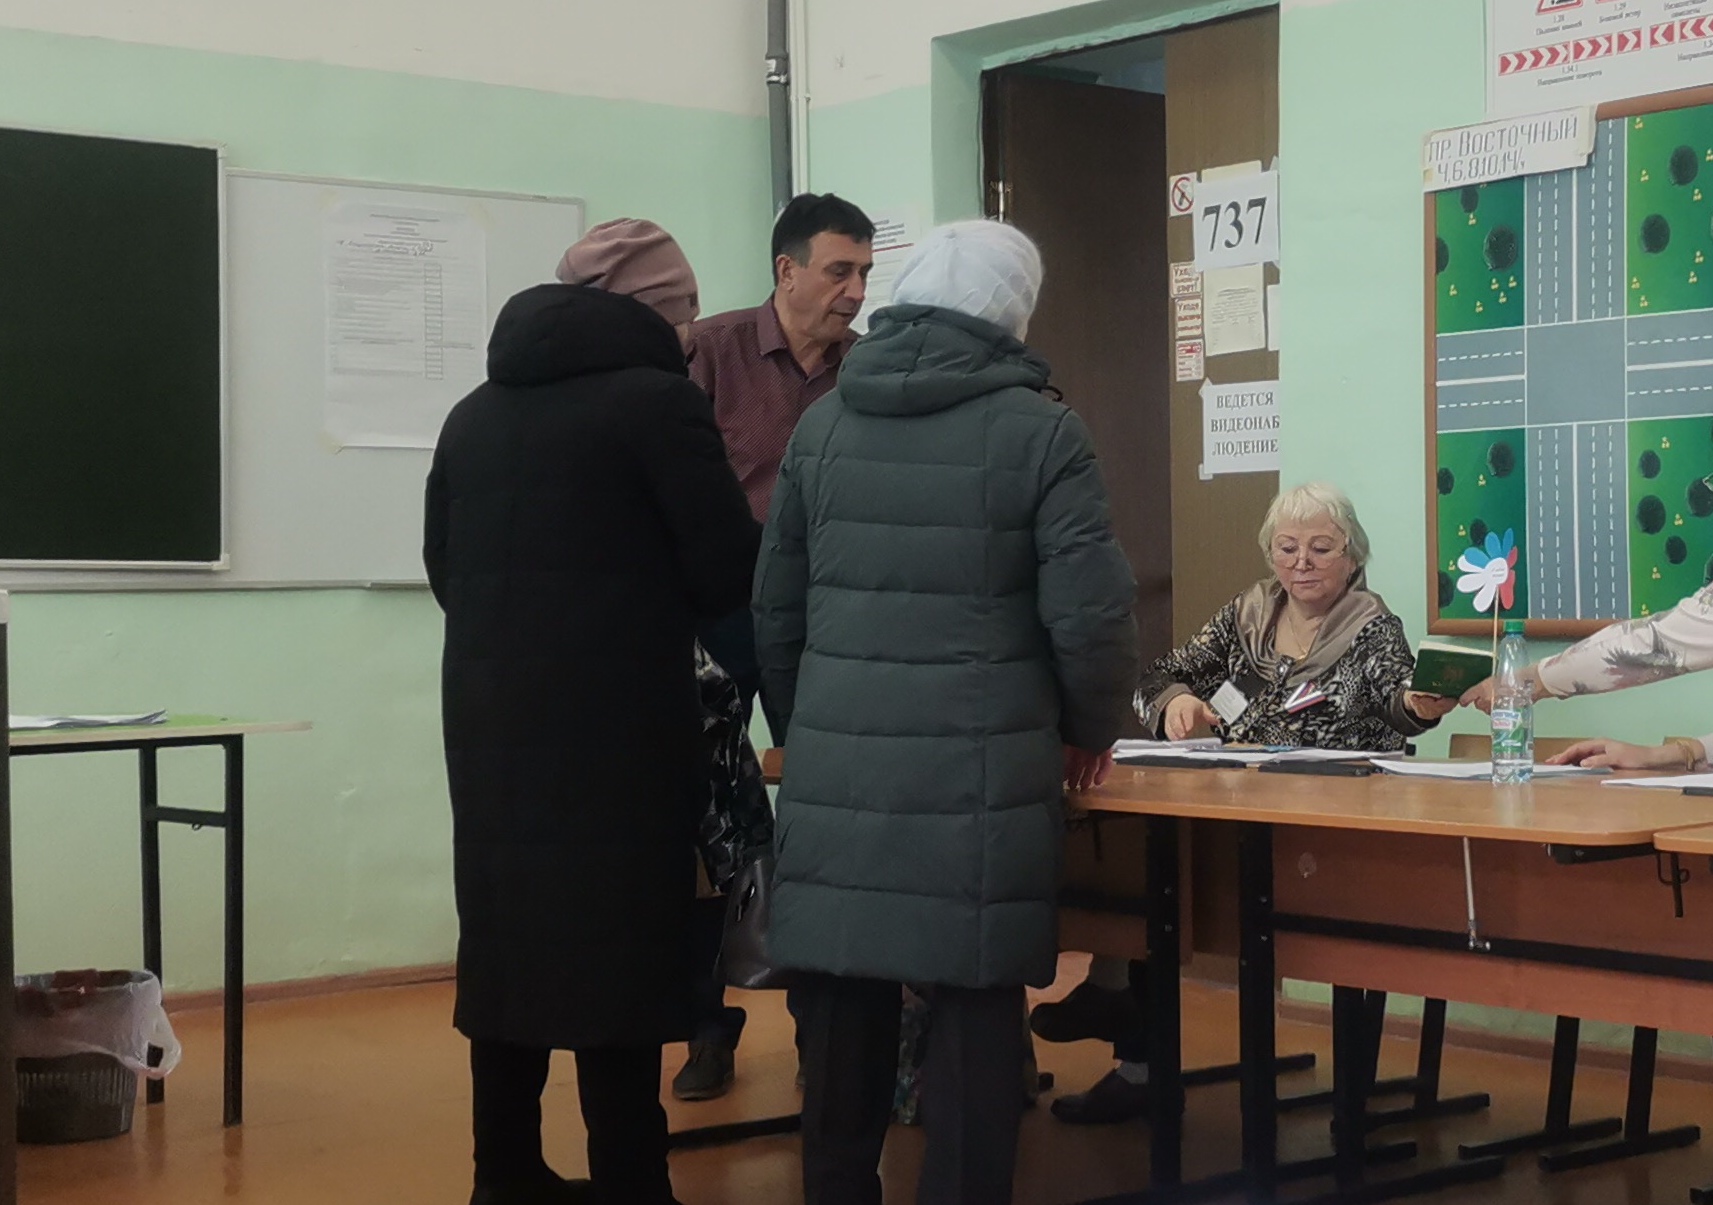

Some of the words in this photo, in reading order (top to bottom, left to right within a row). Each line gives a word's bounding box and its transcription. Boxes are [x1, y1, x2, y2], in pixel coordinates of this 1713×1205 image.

[1202, 196, 1267, 252] 737
[1217, 391, 1274, 411] ВЕДЕТСЯ
[1210, 415, 1280, 433] ВИДЕОНАБ
[1212, 438, 1278, 457] ЛЮДЕНИЕ
